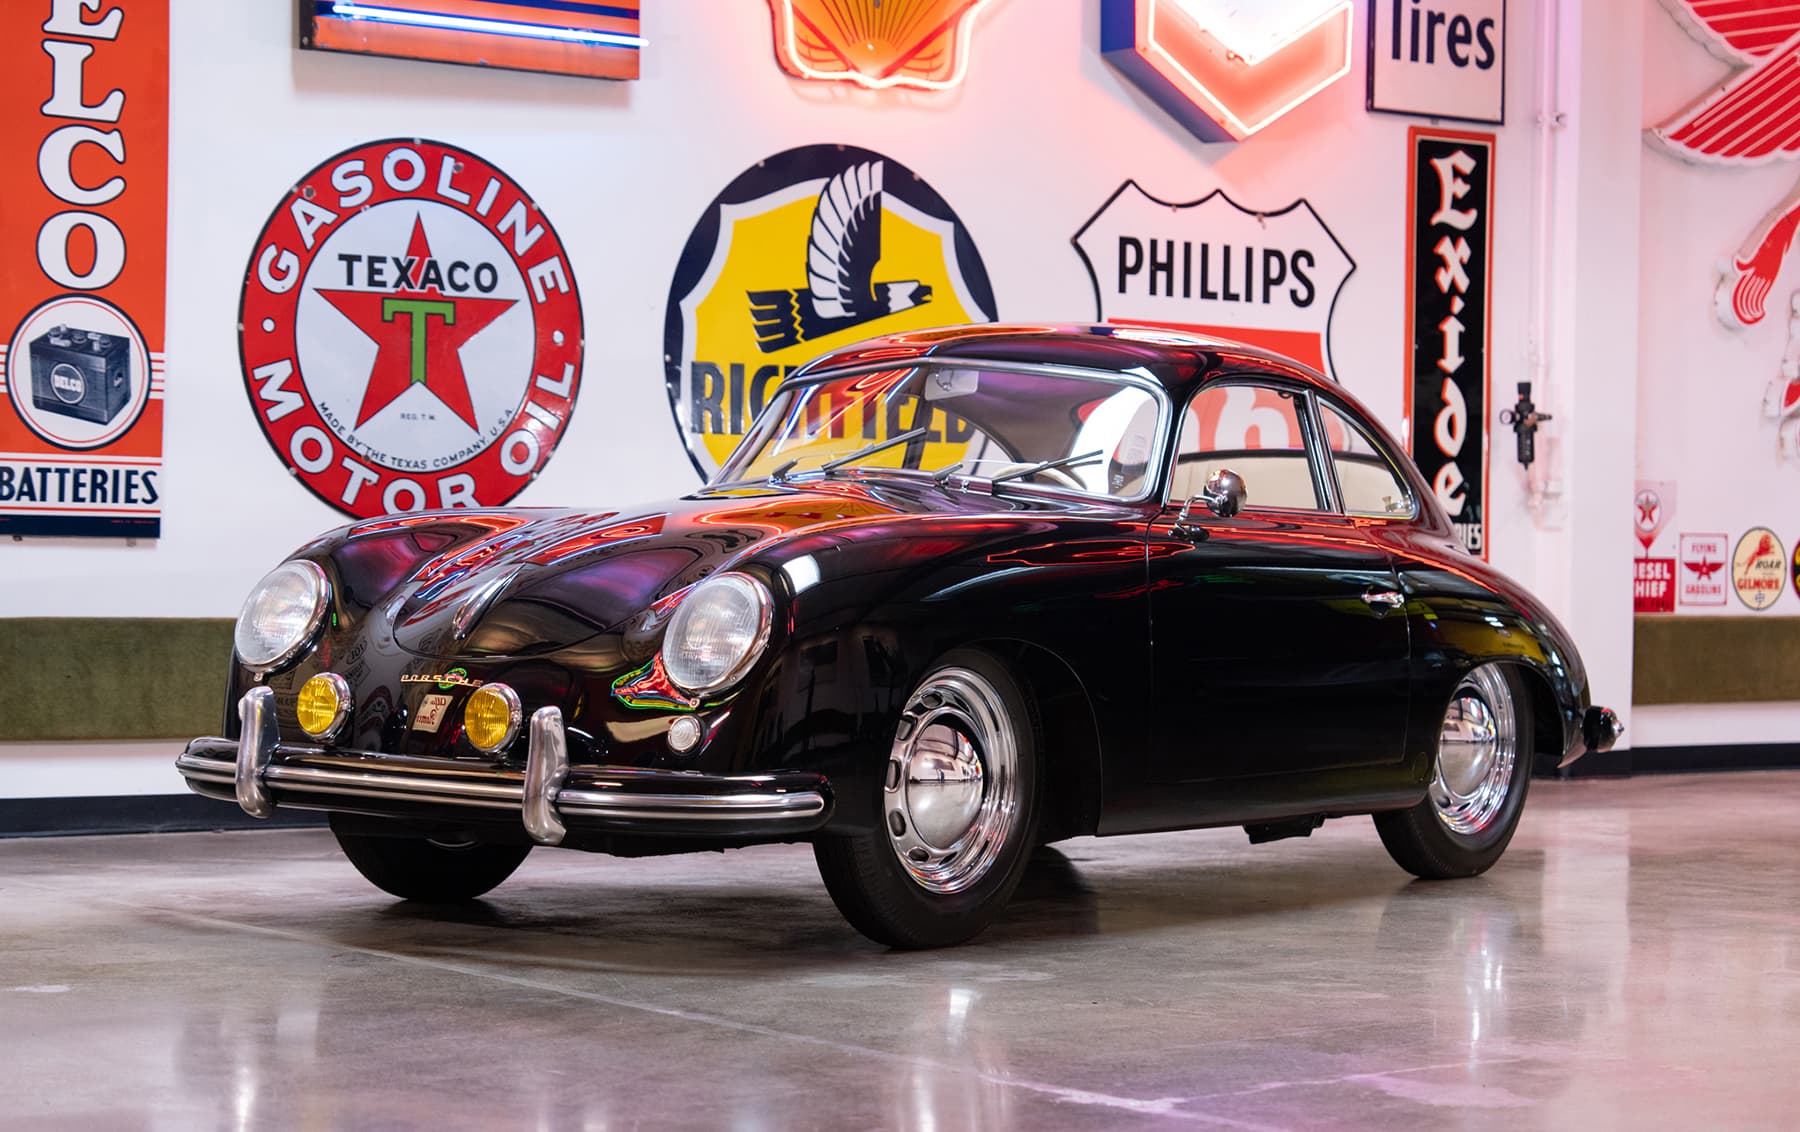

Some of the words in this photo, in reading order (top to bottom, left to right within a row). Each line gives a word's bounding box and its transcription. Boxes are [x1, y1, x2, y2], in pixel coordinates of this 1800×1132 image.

[257, 146, 570, 304] GASOLINE
[338, 253, 499, 293] TEXACO
[1118, 235, 1315, 308] PHILLIPS
[381, 297, 456, 386] T
[1430, 149, 1479, 516] Exide
[252, 357, 482, 514] MOTOR
[500, 362, 576, 478] OIL
[318, 402, 345, 435] MADE
[347, 433, 363, 448] BY
[365, 445, 386, 463] THE
[390, 456, 428, 470] TEXAS
[0, 465, 160, 505] BATTERIES
[1634, 561, 1671, 580] IESEL
[1634, 580, 1668, 598] HIEF
[1737, 577, 1780, 591] GILMORE
